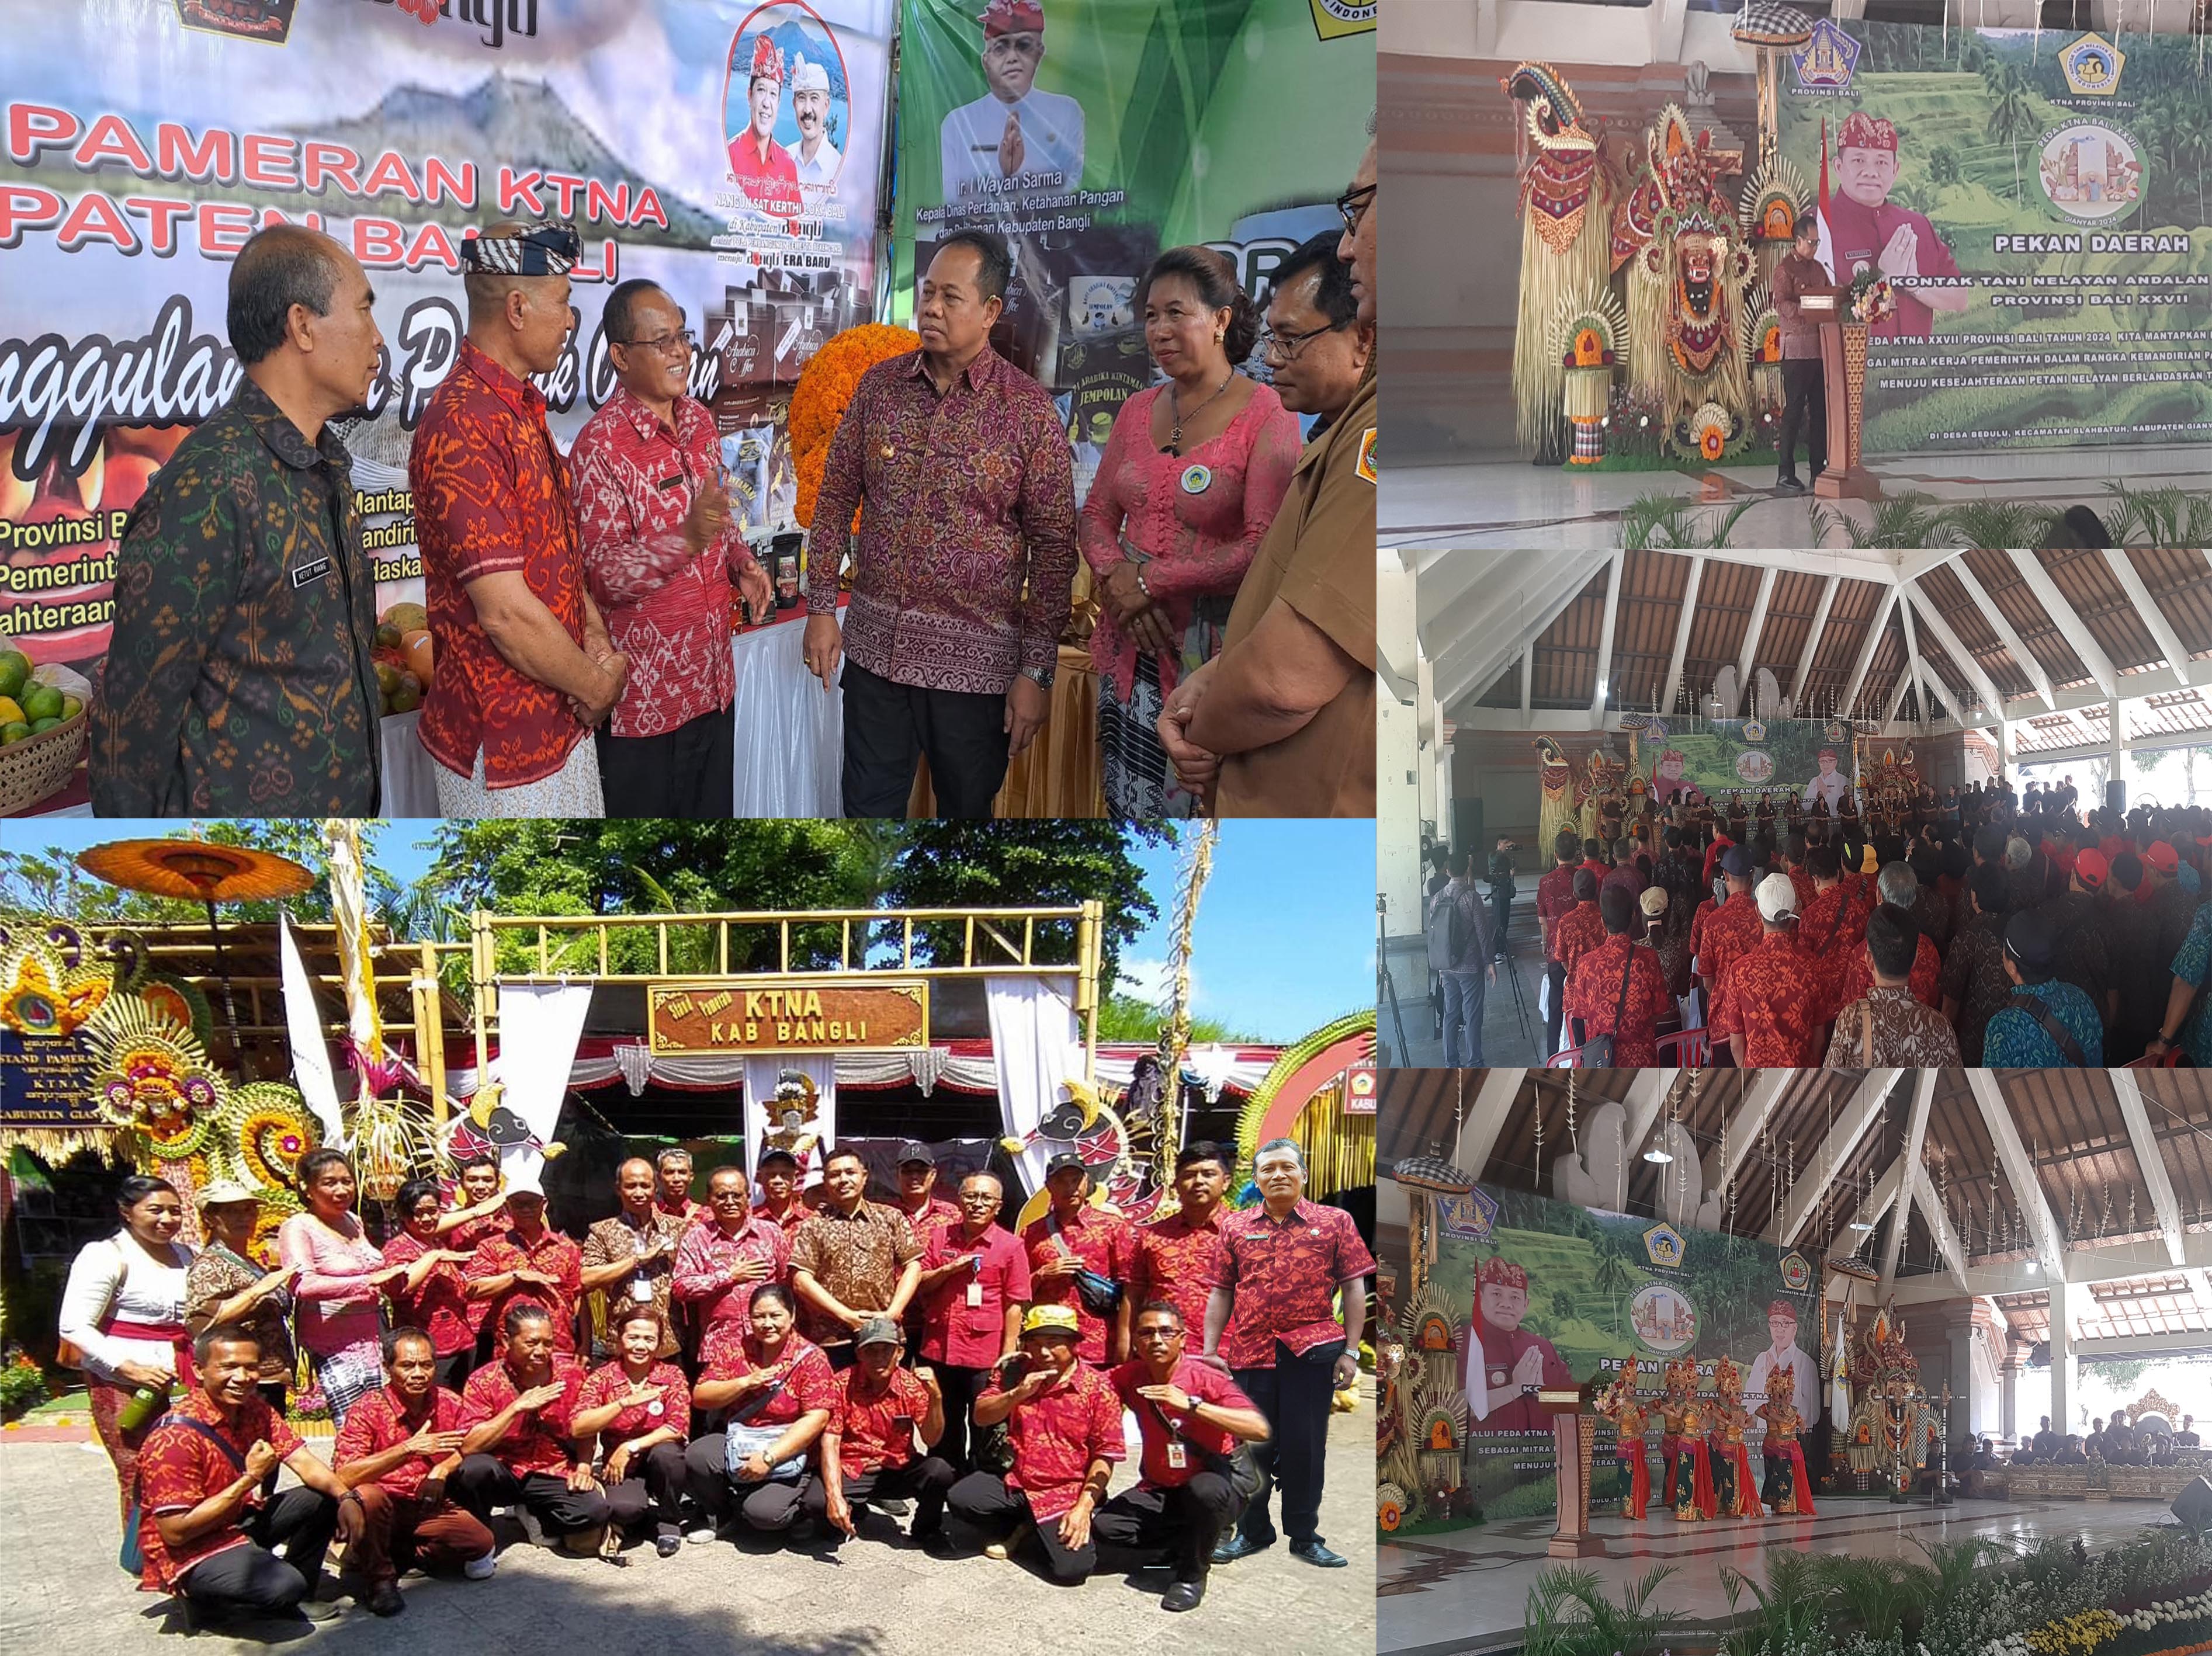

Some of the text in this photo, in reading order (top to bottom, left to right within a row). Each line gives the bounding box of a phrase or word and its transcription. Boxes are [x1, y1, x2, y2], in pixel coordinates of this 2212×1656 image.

[1329, 2, 1377, 19] INDONE
[1791, 88, 1835, 96] PROVINSI
[2037, 118, 2139, 150] PEDA KTNA BALI XXVII
[8, 102, 669, 230] PAMERAN KTNA
[957, 182, 967, 196] Ir.
[976, 176, 1019, 196] Wayan
[1022, 171, 1062, 189] Sarma
[754, 198, 769, 211] SAT
[770, 200, 802, 214] KERTHI
[804, 203, 826, 217] LOKA
[827, 204, 846, 218] BALI
[916, 189, 1124, 223] Kepala Dinas Pertanian, Ketahanan Pangan
[0, 185, 325, 261] PATE
[740, 218, 778, 235] Kabupaten
[997, 218, 1055, 237] Kabupaten
[1058, 212, 1091, 232] Bangli
[2065, 216, 2117, 225] GIANYAR 2024
[1995, 235, 2189, 252] PEKAN DAERAH
[783, 253, 802, 266] ERA
[806, 255, 831, 269] BARU
[1891, 275, 2210, 286] KONTAK TANI NELAYAN ANDALAN
[1003, 298, 1020, 314] ffee
[1991, 294, 2189, 305] PROVINSI BALI XXVII
[1868, 331, 2207, 346] EDA KTNA XXVII PROVINSI BALI TAHUN 2024 KITA MANTAPKAN
[1867, 358, 1887, 367] GAI
[1891, 357, 1927, 367] MITRA
[1931, 356, 1967, 366] KERJA
[1971, 355, 2040, 365] PEMERINTAH
[2044, 354, 2080, 363] DALAM
[2083, 353, 2127, 362] RANGKA
[2131, 351, 2201, 361] KEMANDIRIAN
[1880, 379, 1927, 388] MENUJU
[1932, 376, 2026, 387] KESEJAHTERAAN
[2029, 376, 2068, 385] PETANI
[2071, 374, 2119, 383] NELAYAN
[2123, 371, 2203, 382] BERLANDASKAN
[1079, 387, 1128, 407] JEMPOLAN
[1971, 429, 2011, 438] BEDULU,
[2015, 428, 2071, 436] KECAMATAN
[2133, 423, 2184, 432] KABUPATEN
[356, 489, 414, 515] Mantap
[0, 512, 103, 548] Provinsi
[362, 520, 417, 548] andiri
[0, 553, 117, 591] Pemerint
[667, 992, 694, 1020] Stand
[745, 990, 823, 1019] KTNA
[710, 1020, 867, 1043] KAB BANGLI
[46, 1054, 93, 1064] PAMERA
[1440, 1231, 1478, 1242] PROVINSI
[1655, 1268, 1680, 1276] PROVINSI
[1629, 1285, 1644, 1299] PEDA
[1645, 1280, 1663, 1289] KTNA
[1665, 1282, 1679, 1292] BALI
[1647, 1348, 1668, 1356] GIANYAR
[1600, 1359, 1658, 1373] PEAN
[1478, 1446, 1519, 1454] SEBAGAI
[1522, 1445, 1551, 1453] MITRA
[1513, 1461, 1551, 1470] MENUJU
